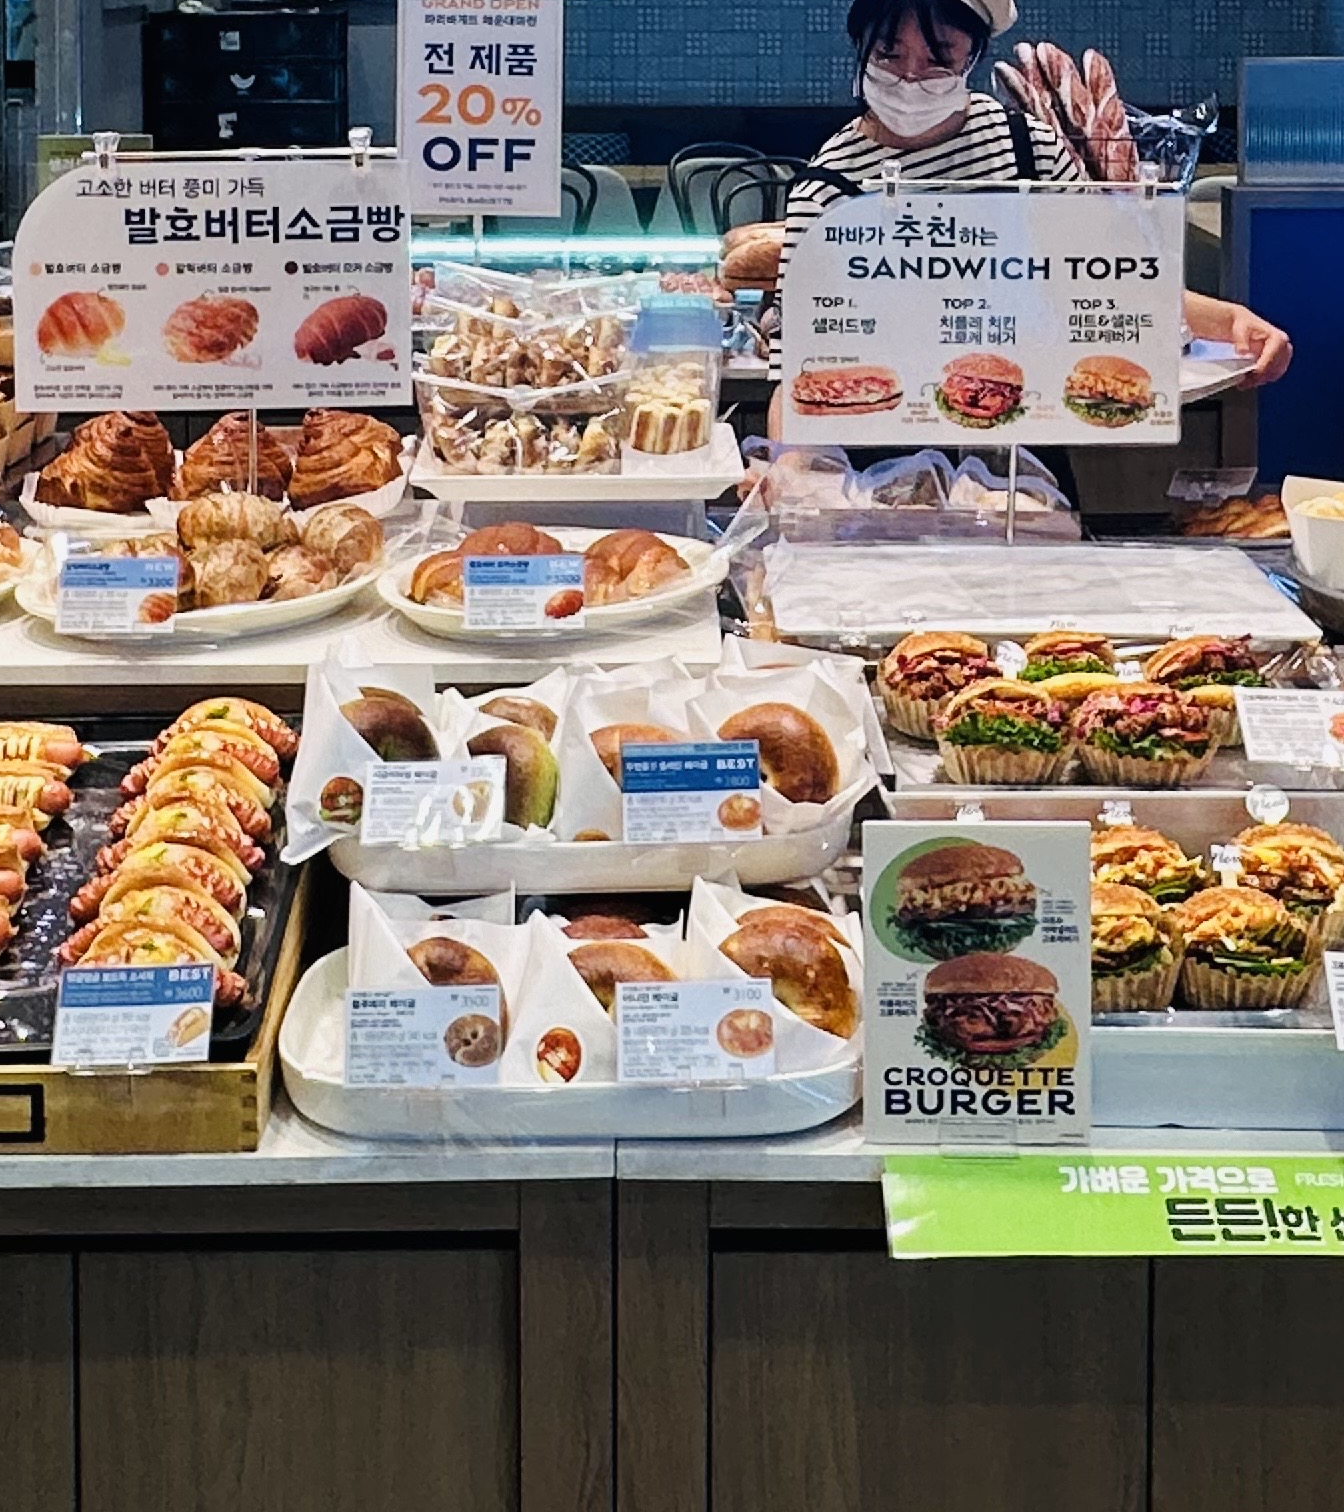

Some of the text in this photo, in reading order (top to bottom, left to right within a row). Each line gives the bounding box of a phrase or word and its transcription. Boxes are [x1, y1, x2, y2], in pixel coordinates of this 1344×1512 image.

[424, 42, 537, 76] 전 제품
[416, 82, 542, 127] 20%
[422, 136, 536, 173] OFF
[76, 177, 265, 199] 고소한 버터 풍미 가득
[124, 205, 406, 244] 발효버터소금빵
[824, 225, 886, 247] 파바가
[847, 256, 1161, 281] SANDWICH TOP3
[812, 296, 844, 309] TOP
[943, 298, 974, 310] TOP
[1072, 298, 1102, 310] TOP
[812, 317, 876, 335] 샐러드빵
[716, 758, 756, 770] BEST
[168, 967, 211, 982] BEST
[883, 1066, 1076, 1088] CROQUETTE
[884, 1088, 1077, 1116] BURGER
[1058, 1165, 1280, 1196] 가벼운 가격으로
[1166, 1197, 1321, 1243] 든든!한
